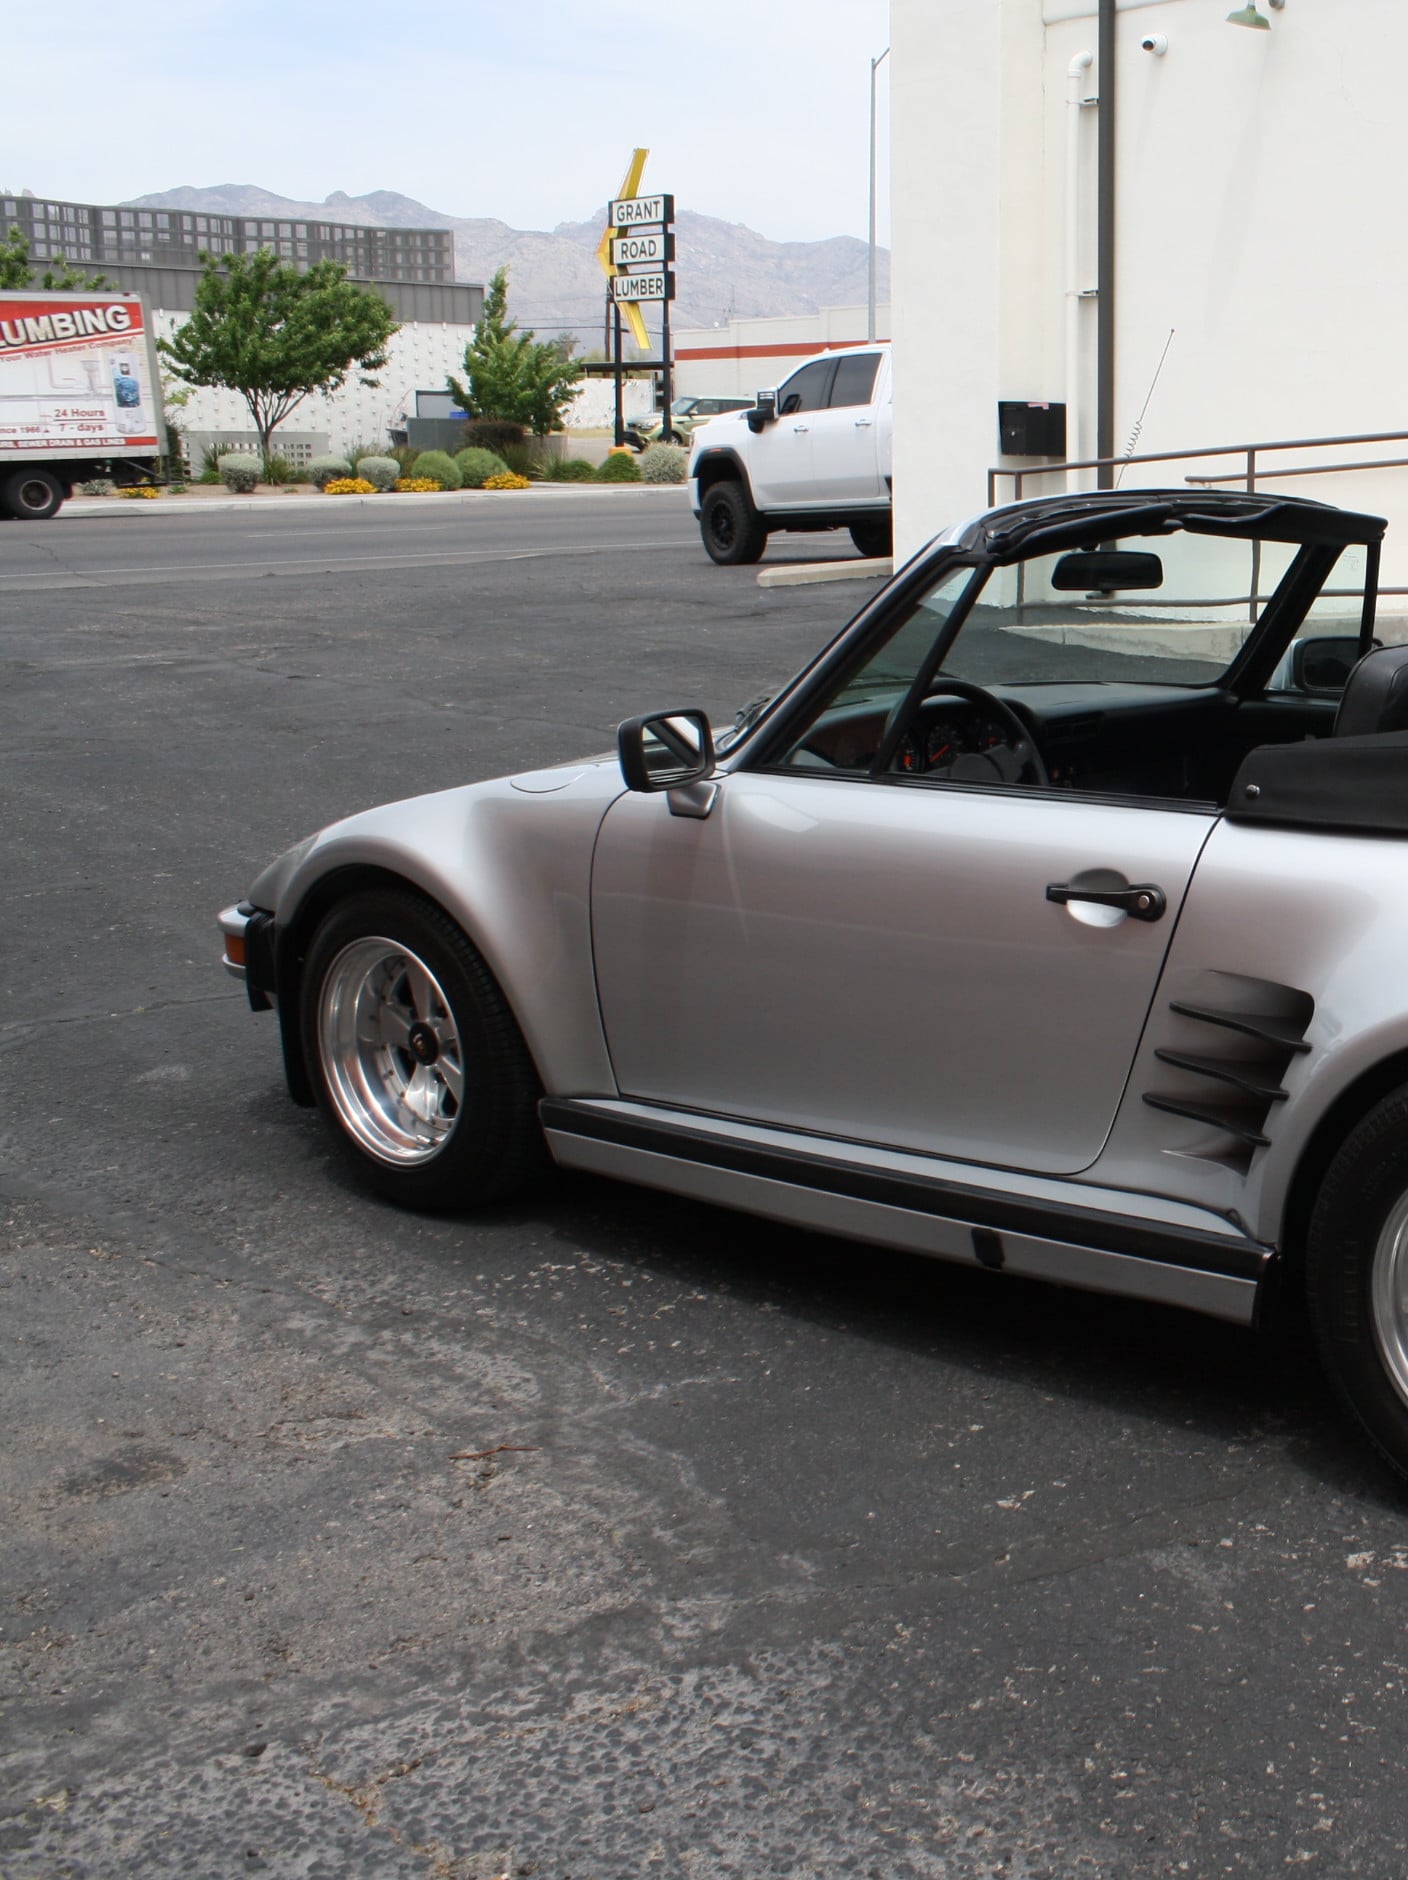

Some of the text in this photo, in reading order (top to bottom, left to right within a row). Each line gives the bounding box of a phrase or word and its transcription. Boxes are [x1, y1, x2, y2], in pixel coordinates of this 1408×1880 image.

[616, 201, 660, 222] GRANT
[621, 240, 657, 260] ROAD
[615, 278, 663, 297] LUMBER
[24, 350, 52, 359] Water
[54, 409, 105, 418] 24 Hours
[60, 424, 65, 433] 7
[77, 423, 104, 434] days
